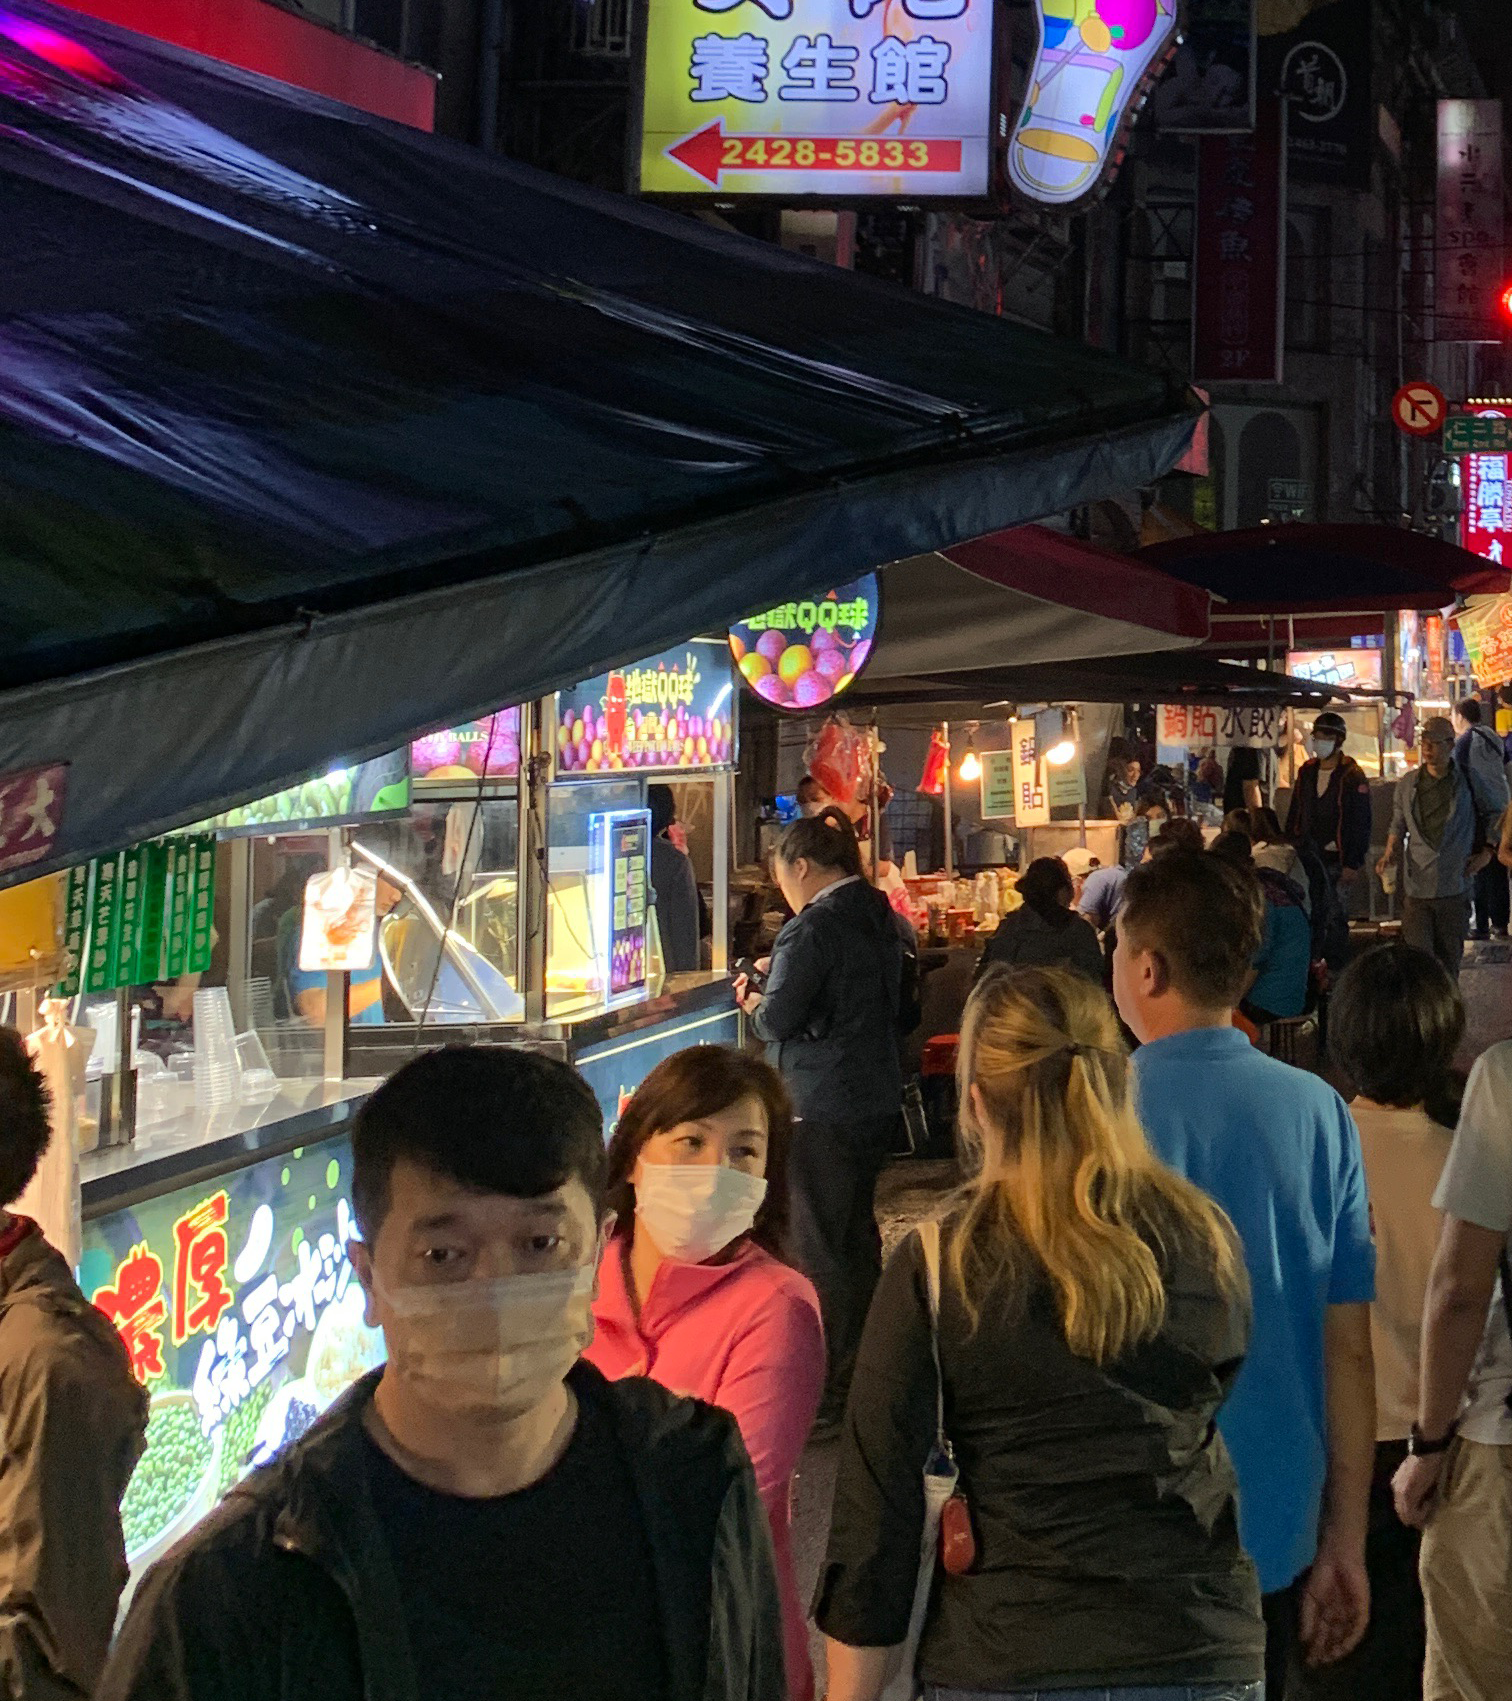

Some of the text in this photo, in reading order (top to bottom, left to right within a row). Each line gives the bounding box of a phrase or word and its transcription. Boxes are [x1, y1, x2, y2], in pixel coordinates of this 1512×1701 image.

[689, 33, 951, 104] 養生館
[721, 139, 929, 168] 2428-5833
[448, 731, 489, 743] BALLS
[1163, 704, 1275, 741] 鍋貼水餃
